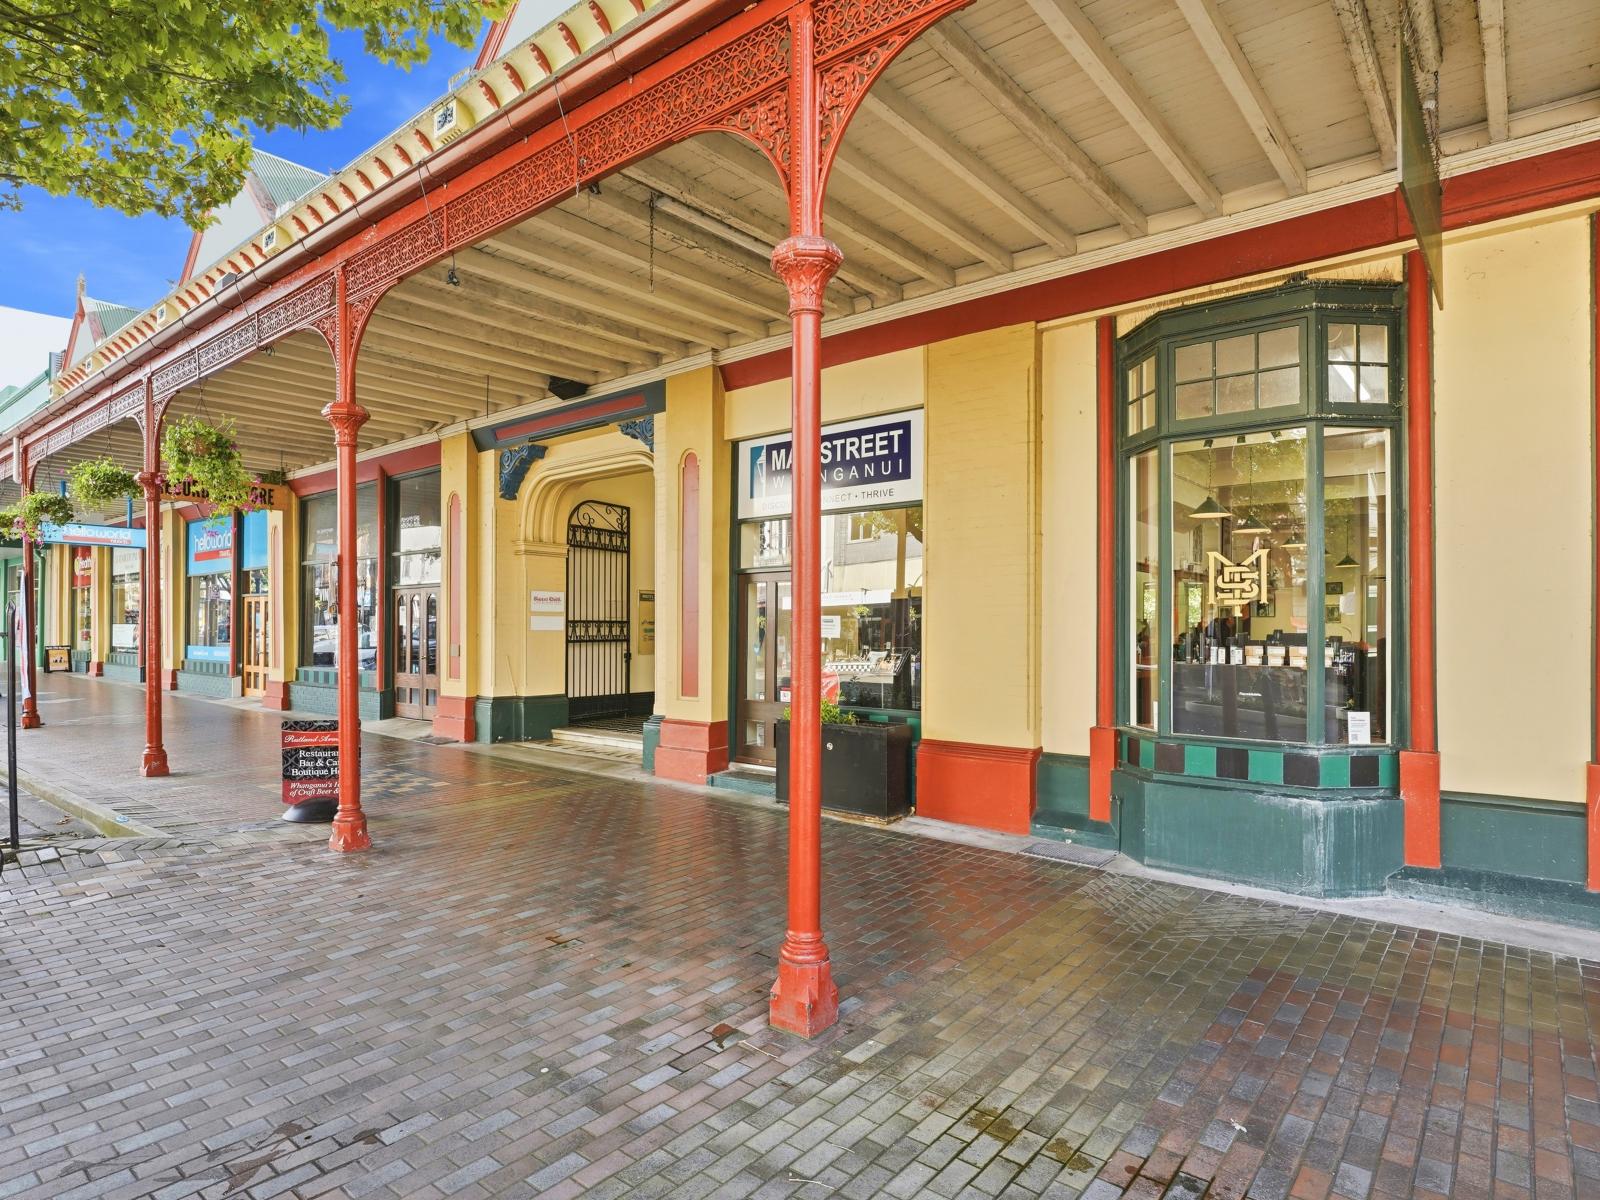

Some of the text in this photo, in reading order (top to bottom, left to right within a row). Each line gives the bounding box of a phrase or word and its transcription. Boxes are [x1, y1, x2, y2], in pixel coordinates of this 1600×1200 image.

[772, 459, 904, 489] WNGANUI
[861, 488, 895, 500] THRIVE
[284, 734, 339, 743] Rutland Arm
[292, 769, 328, 777] Boutique
[290, 789, 297, 798] of
[298, 788, 316, 796] Craft
